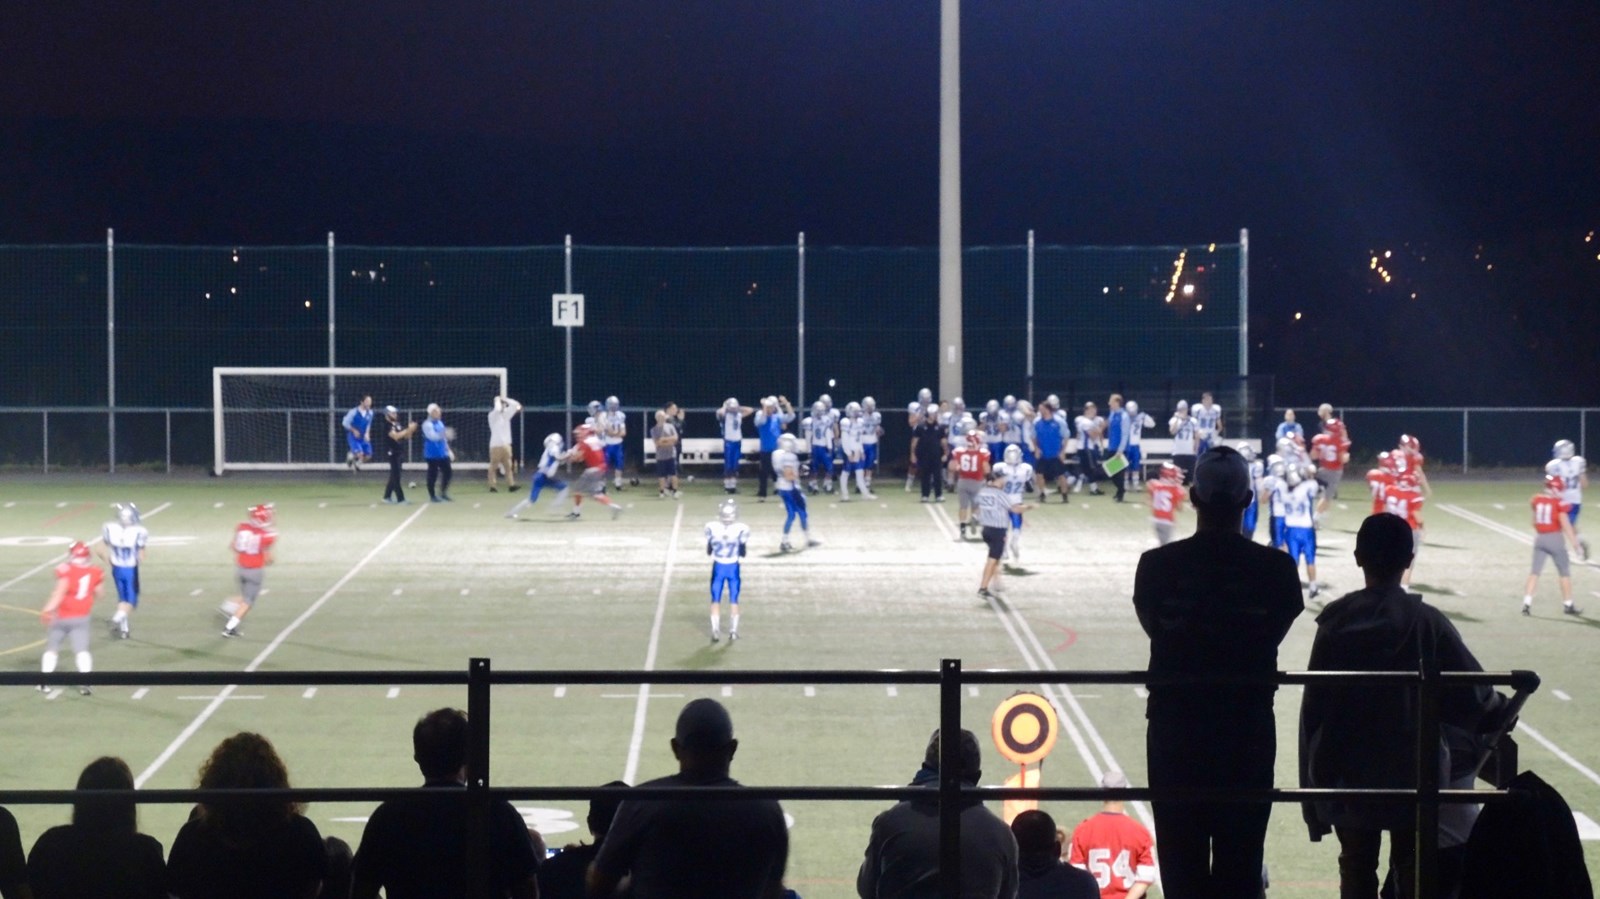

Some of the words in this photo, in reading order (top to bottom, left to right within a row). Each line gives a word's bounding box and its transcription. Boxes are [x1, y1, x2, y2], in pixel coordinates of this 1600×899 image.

[558, 300, 579, 320] F1
[961, 454, 978, 472] 61
[1535, 503, 1552, 525] 11
[711, 541, 738, 559] 27
[76, 573, 91, 600] 1
[1088, 848, 1135, 889] 54
